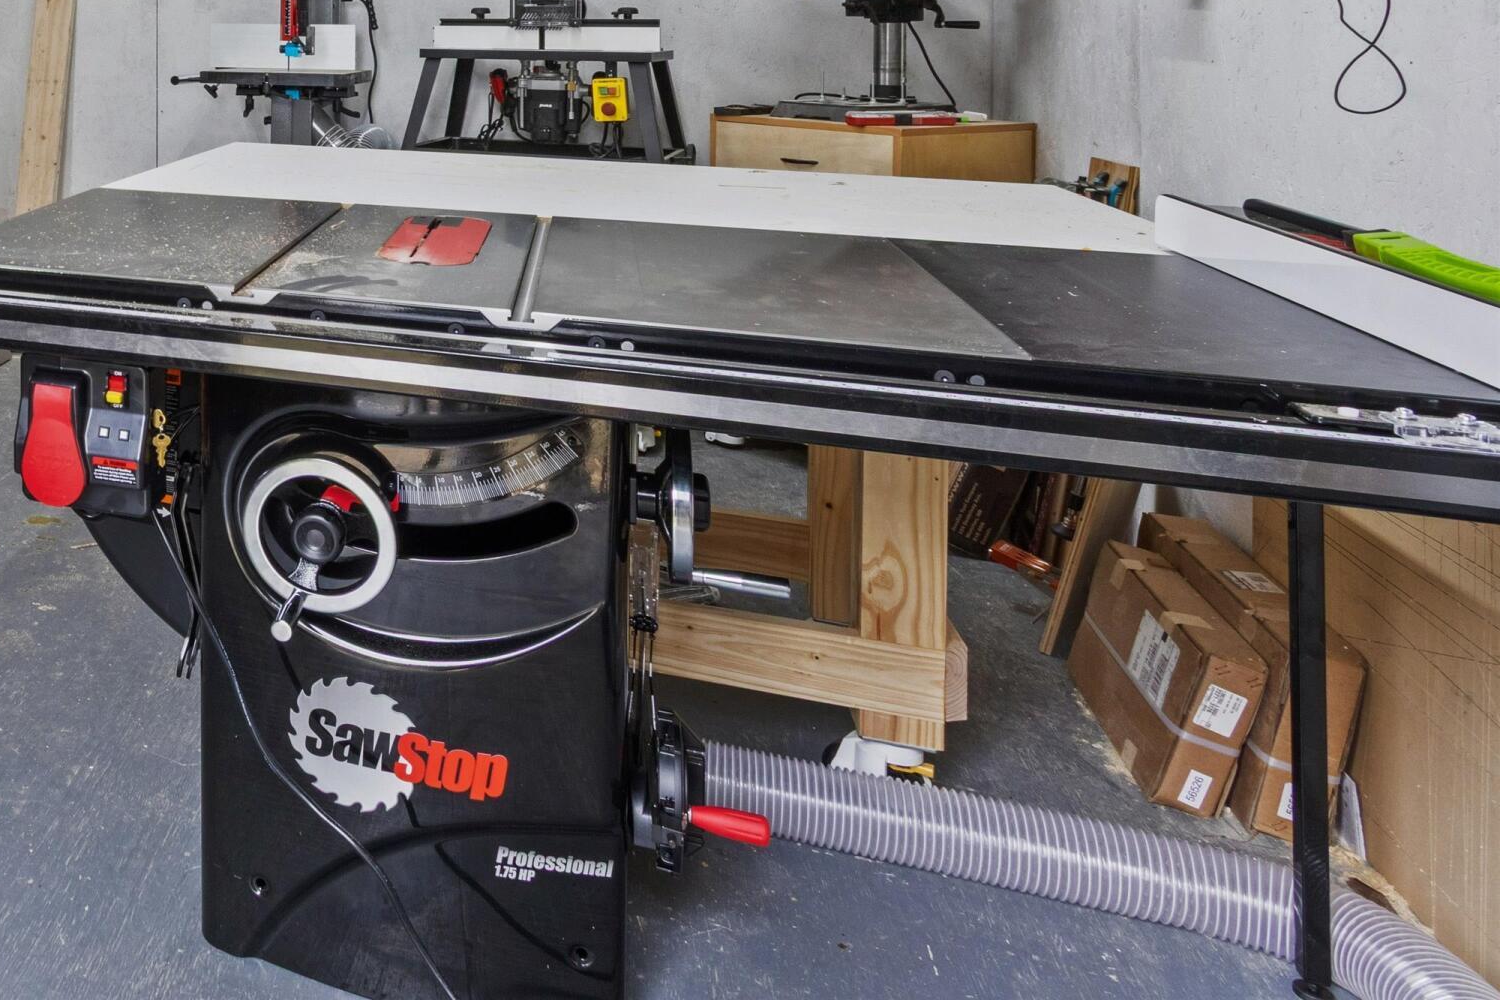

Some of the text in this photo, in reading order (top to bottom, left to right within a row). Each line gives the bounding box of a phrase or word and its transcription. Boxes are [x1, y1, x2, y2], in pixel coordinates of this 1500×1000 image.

[1185, 776, 1204, 802] 56526
[494, 864, 536, 882] 1.75 HP
[496, 846, 615, 878] Professional
